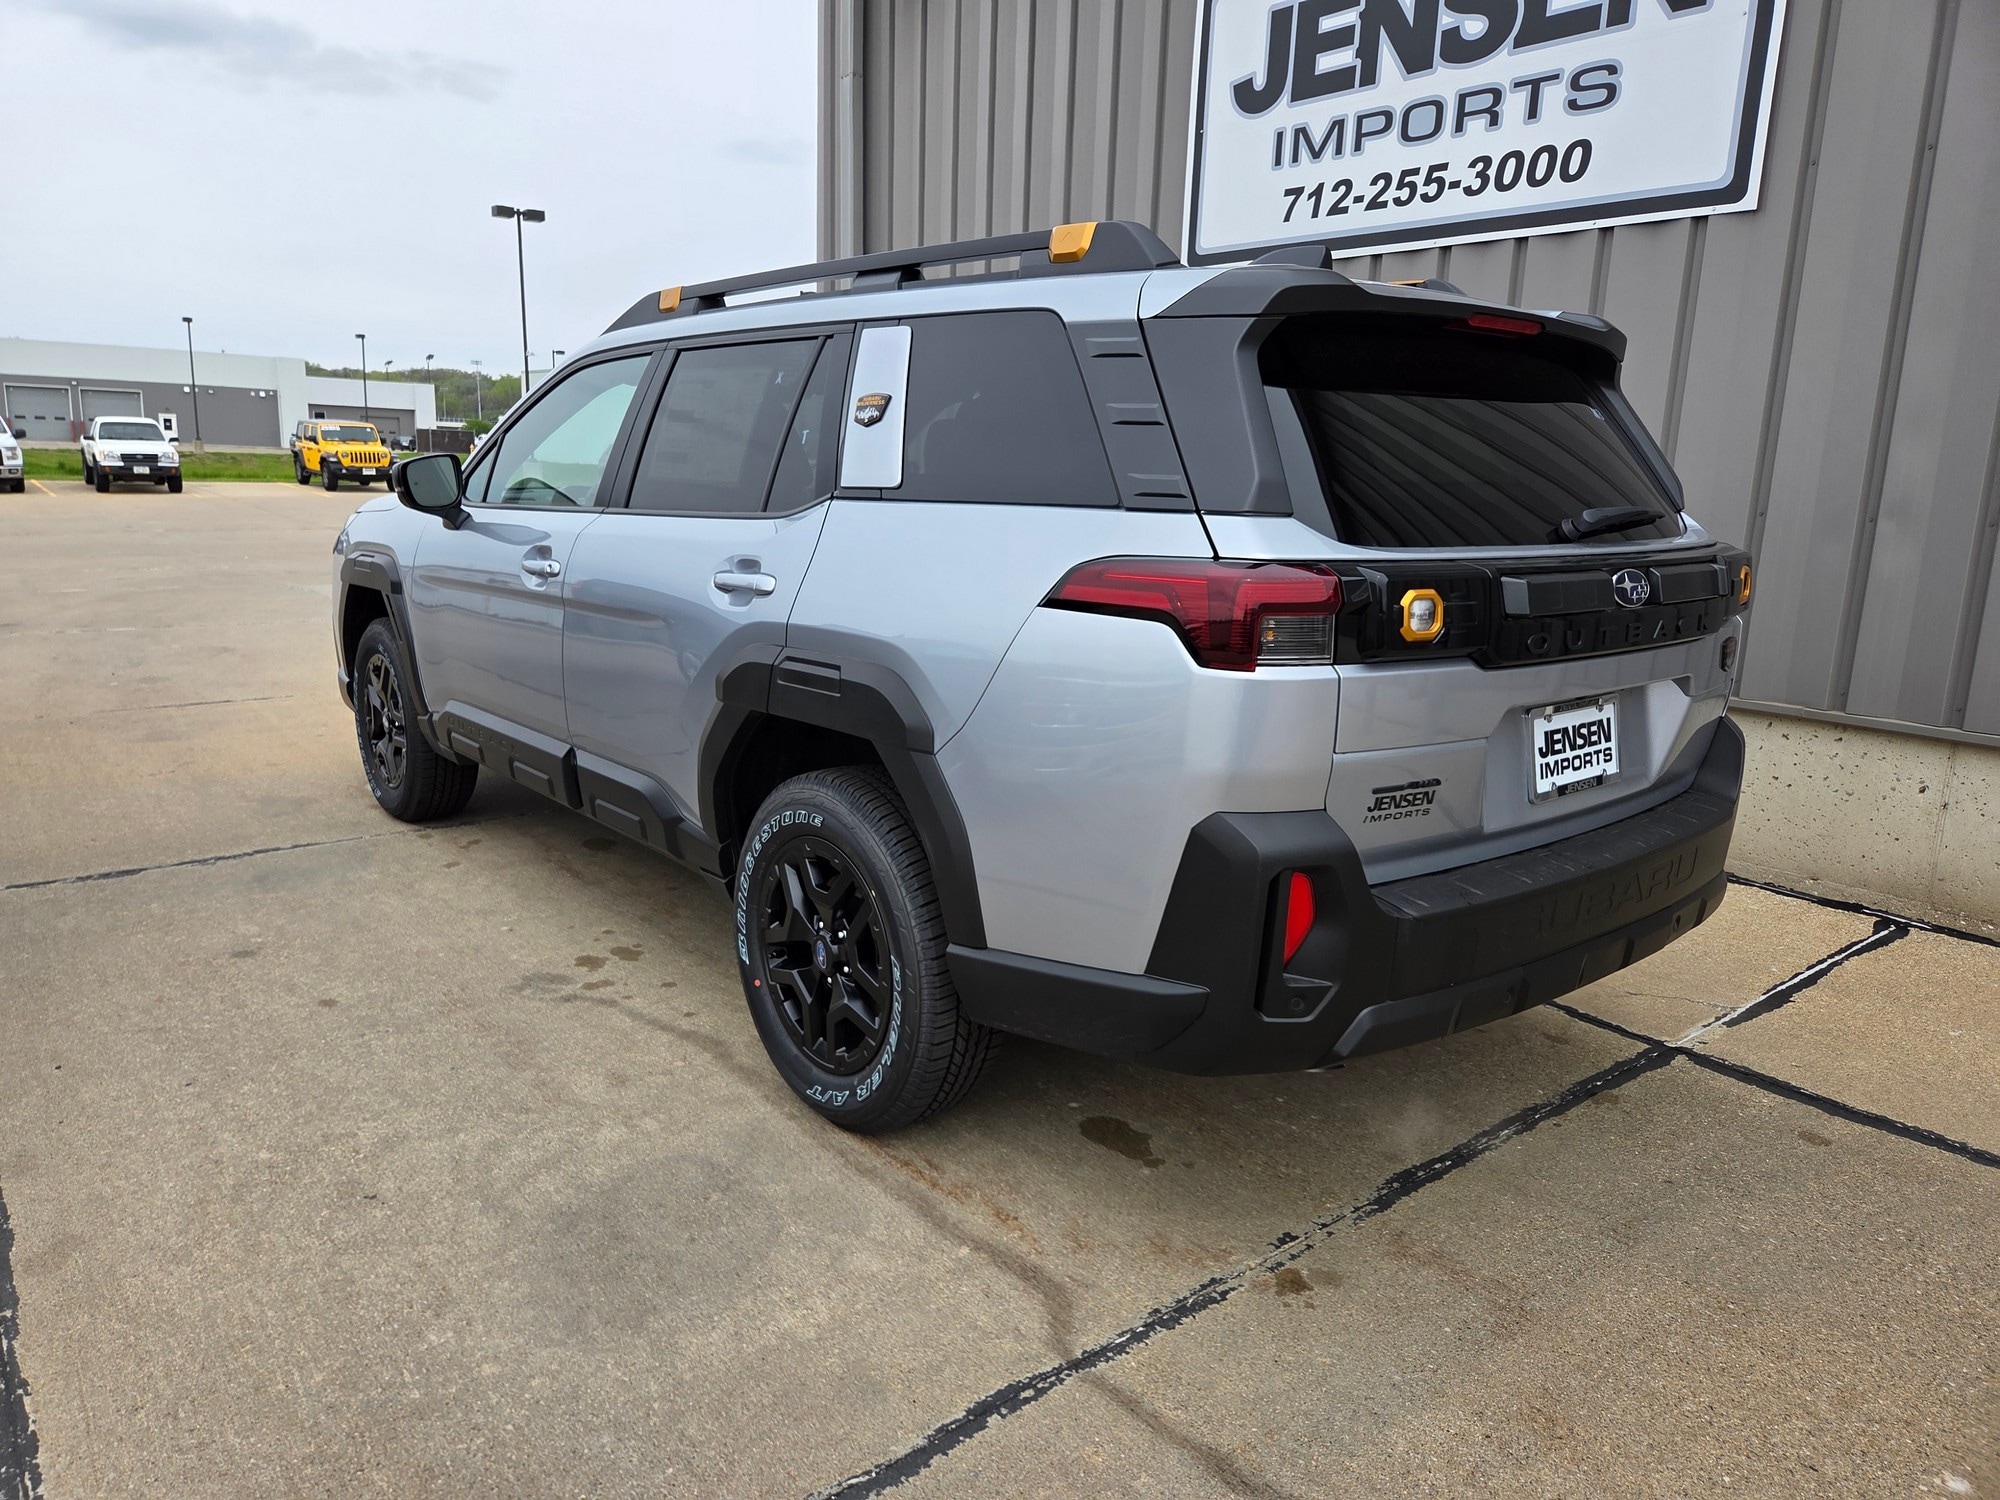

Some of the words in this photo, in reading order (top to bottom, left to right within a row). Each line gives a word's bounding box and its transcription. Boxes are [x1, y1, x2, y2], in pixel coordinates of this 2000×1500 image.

[1232, 0, 1706, 115] JENS
[1272, 61, 1622, 169] IMPORTS
[1282, 138, 1593, 223] 712-255-3000
[1526, 612, 1709, 655] OUTBACK
[1537, 716, 1612, 759] JENSEN
[1539, 746, 1613, 780] IMPORTS
[1366, 789, 1437, 813] JENSEN
[1564, 777, 1598, 795] JENSEN
[1362, 807, 1432, 824] IMPORTS
[737, 810, 824, 966] BRIDGESTONE
[856, 954, 902, 1101] DUELER
[806, 1085, 850, 1106] A/T
